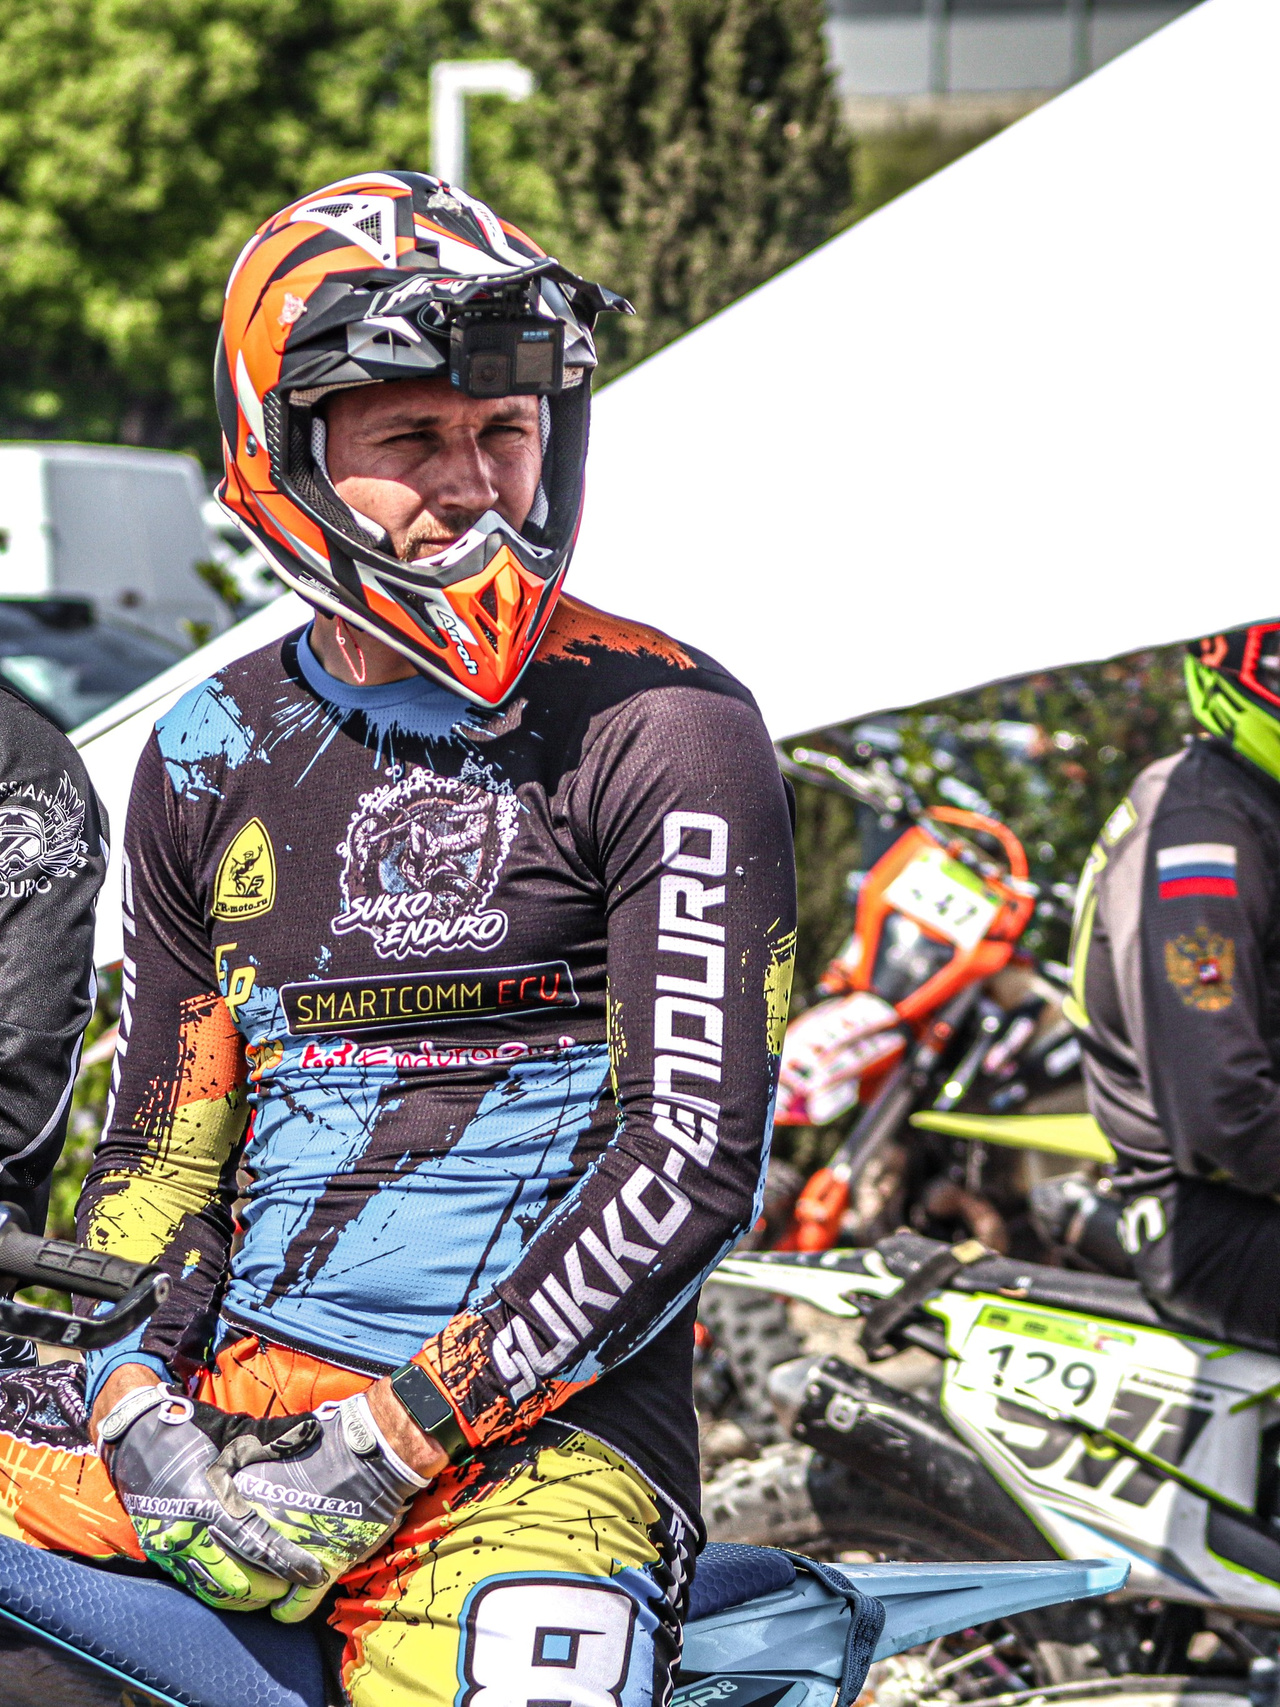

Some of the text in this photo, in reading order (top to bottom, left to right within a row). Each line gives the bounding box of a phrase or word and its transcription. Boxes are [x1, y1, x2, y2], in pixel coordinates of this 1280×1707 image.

[436, 608, 478, 675] Airoh
[338, 892, 432, 926] SUKKO
[381, 916, 504, 949] ENDURO
[297, 982, 482, 1022] SMARTCOMM
